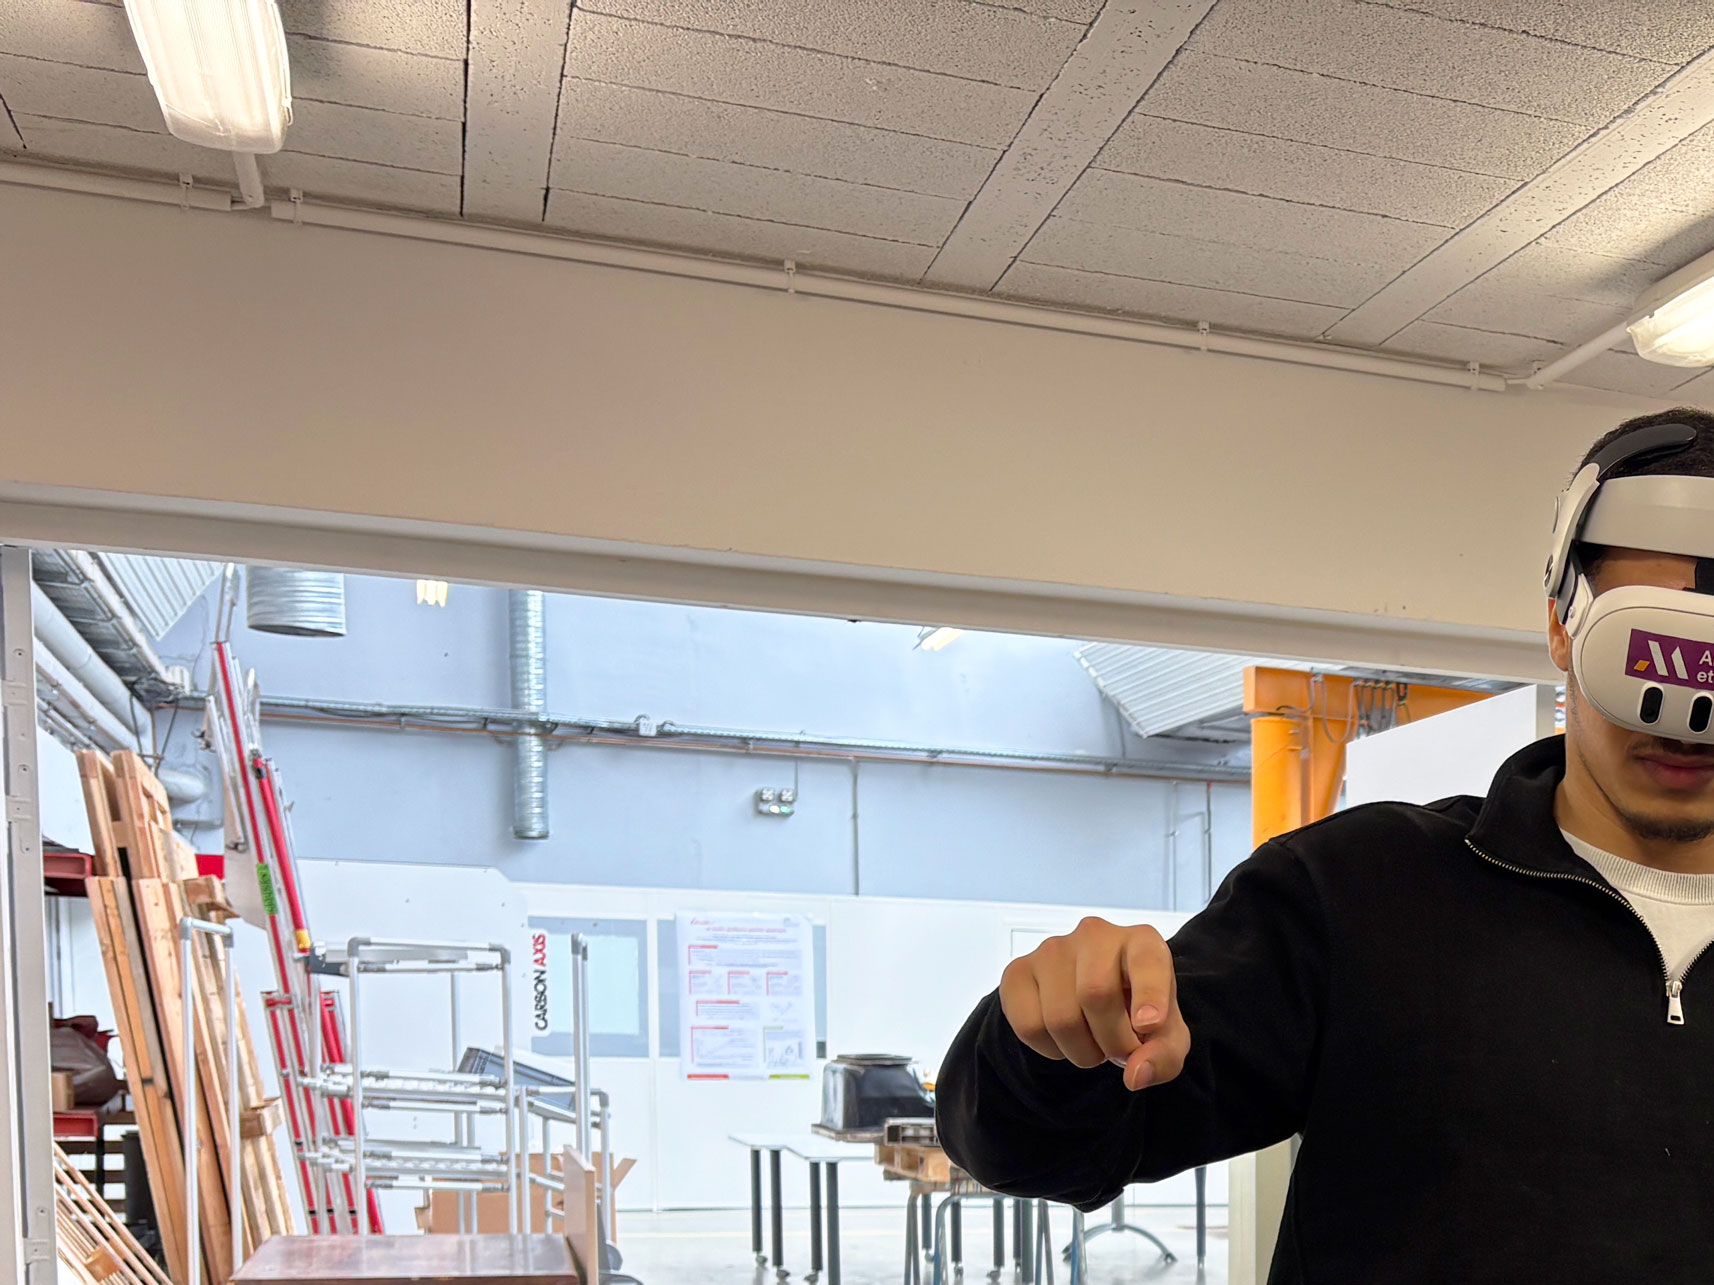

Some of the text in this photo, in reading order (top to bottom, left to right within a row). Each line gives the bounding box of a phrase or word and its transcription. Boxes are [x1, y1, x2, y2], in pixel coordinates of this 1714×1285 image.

[1697, 670, 1714, 683] et
[532, 933, 548, 1031] CARBON AXIS
